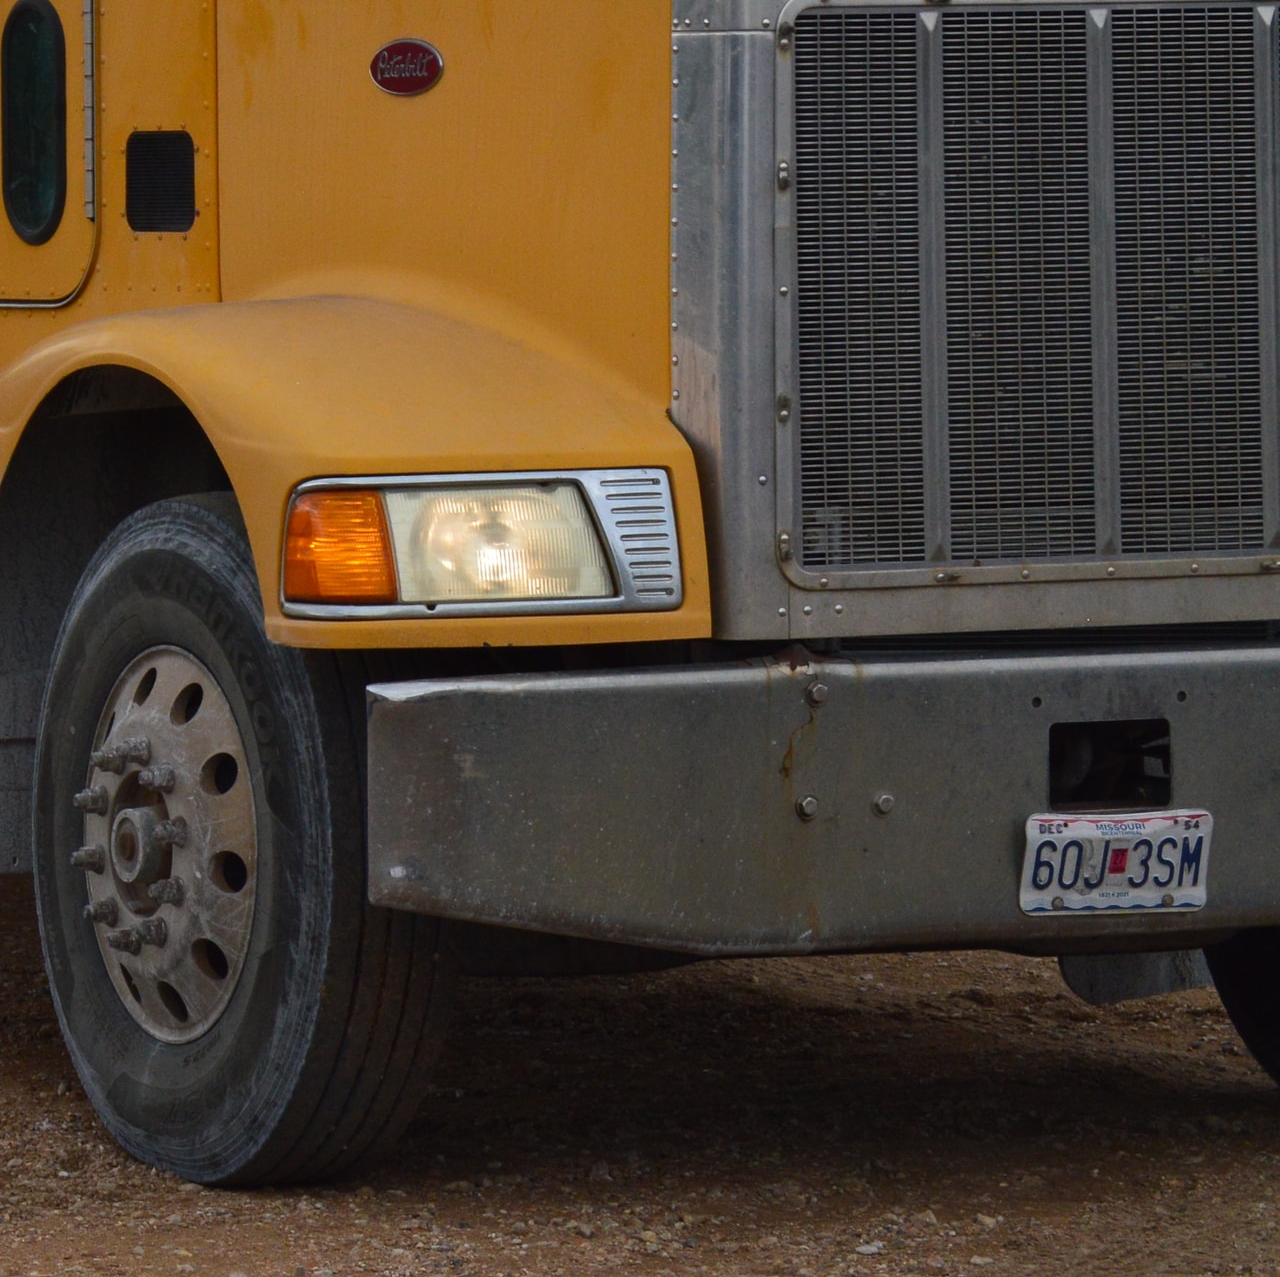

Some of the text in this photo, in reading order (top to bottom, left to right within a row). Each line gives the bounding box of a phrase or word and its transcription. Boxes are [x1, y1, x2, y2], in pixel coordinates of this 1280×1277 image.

[377, 50, 435, 81] Peterbilt
[1039, 823, 1064, 834] DEC
[1095, 822, 1147, 832] MISSOURI
[1031, 835, 1204, 891] 60J 3SM
